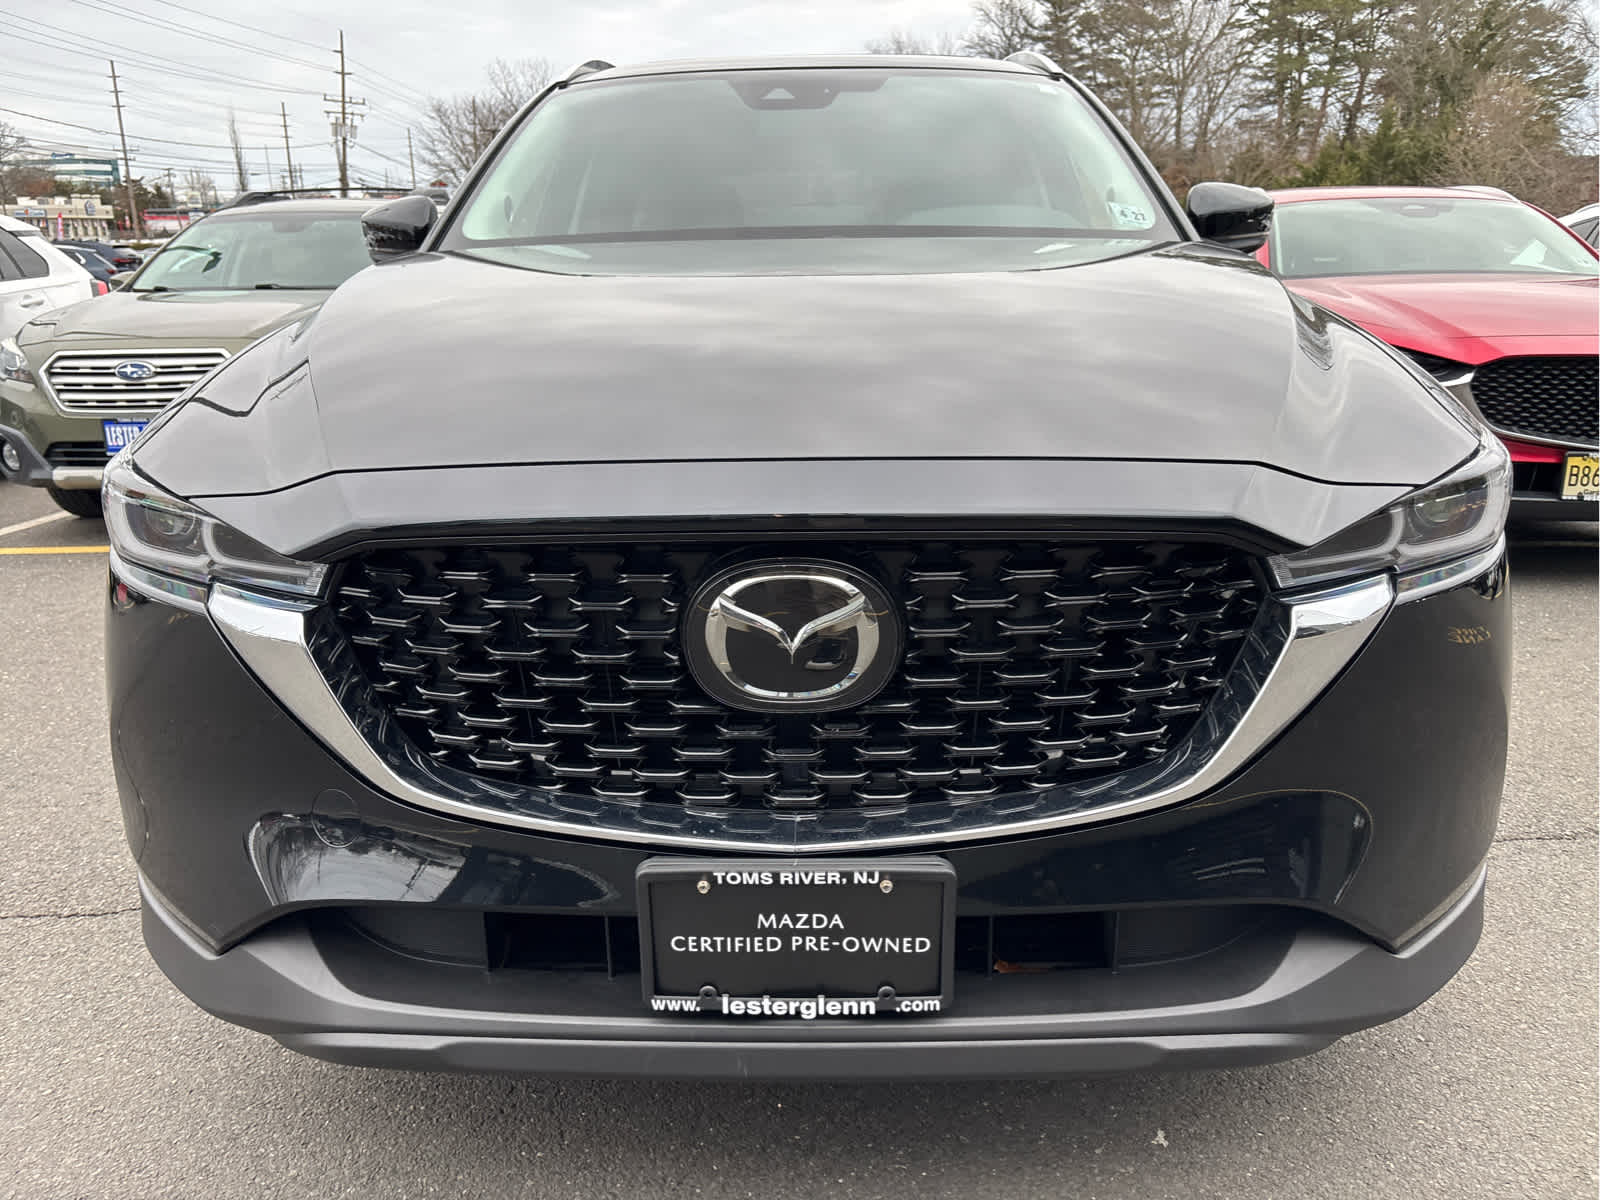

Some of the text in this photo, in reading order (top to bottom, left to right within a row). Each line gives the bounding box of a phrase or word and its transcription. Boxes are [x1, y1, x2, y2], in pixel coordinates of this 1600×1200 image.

[713, 871, 880, 885] TOMS RIVER, NJ
[757, 913, 845, 929] MAZDA
[670, 935, 931, 953] CERTIFIED PRE-OWNED
[651, 994, 941, 1019] www. lesterglenn .com
